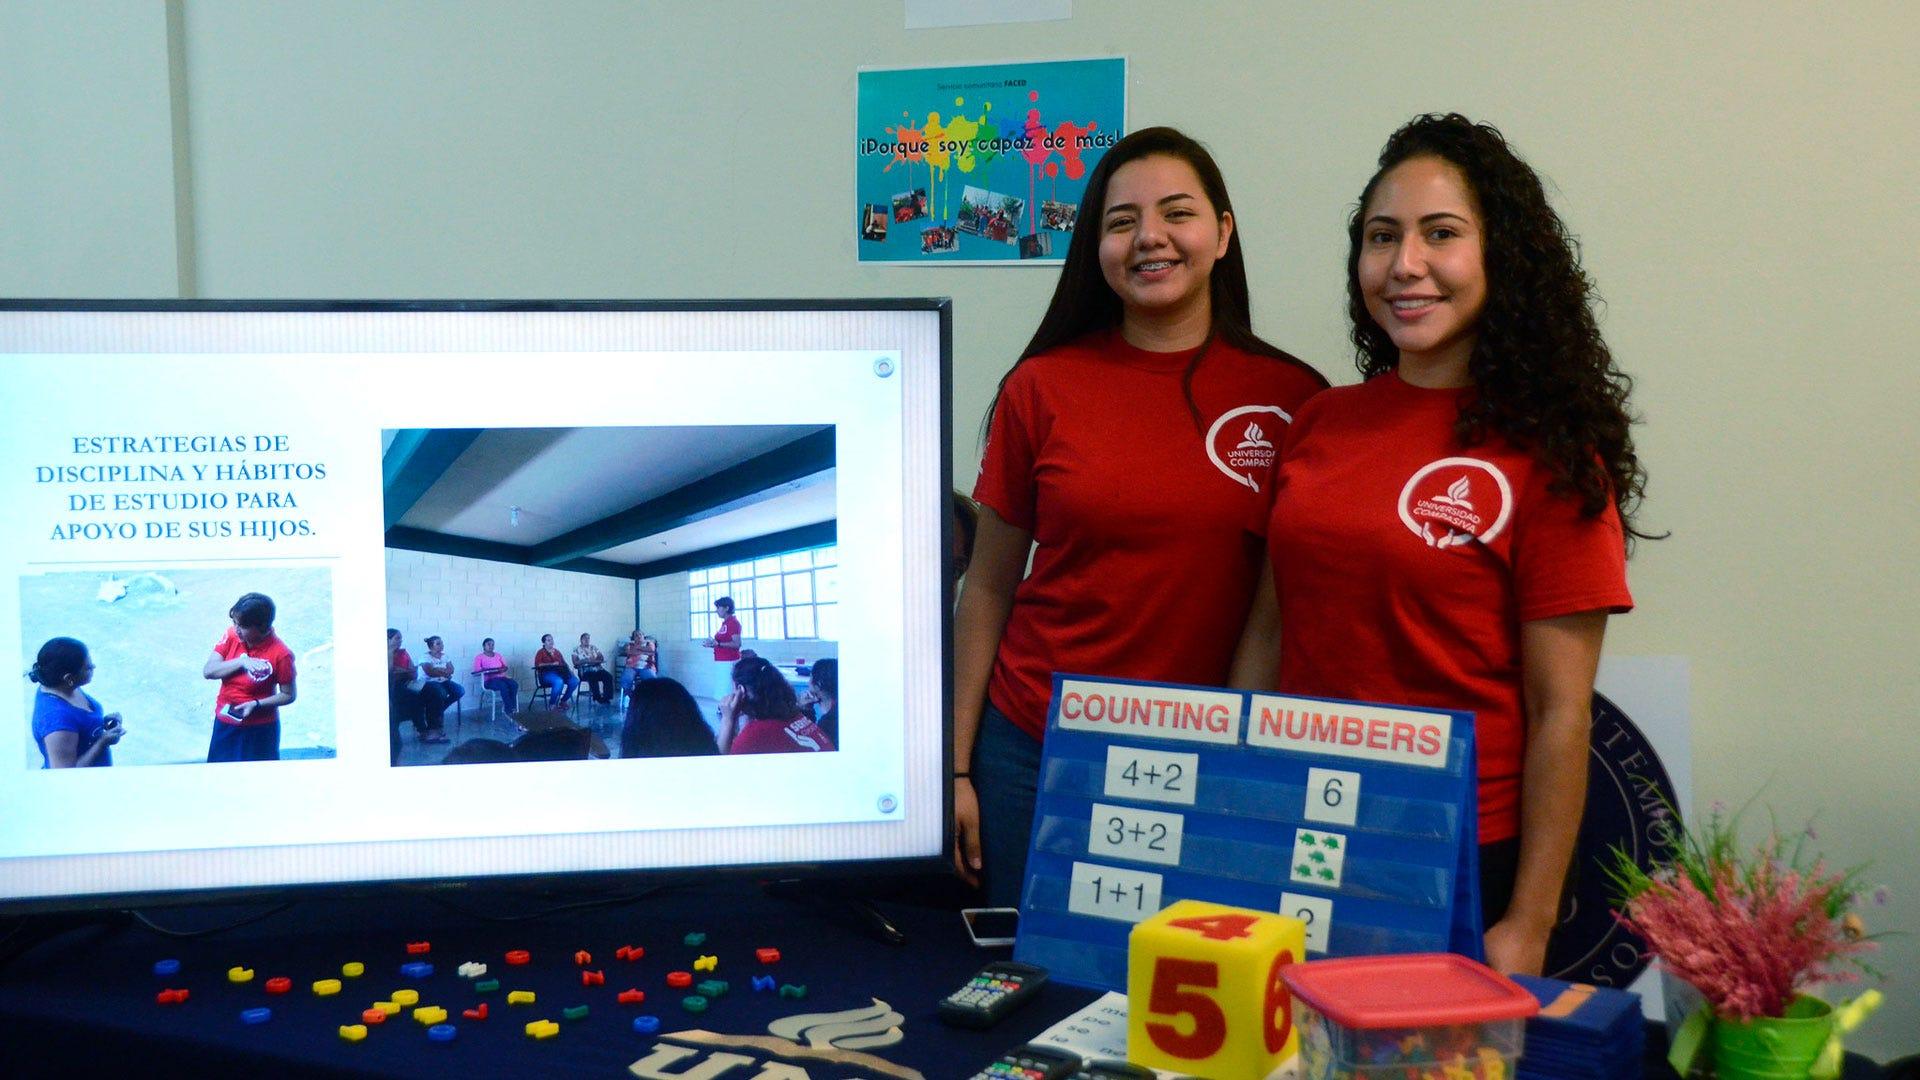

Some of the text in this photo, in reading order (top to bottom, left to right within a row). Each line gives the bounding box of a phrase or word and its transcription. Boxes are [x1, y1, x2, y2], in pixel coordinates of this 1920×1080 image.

[938, 138, 971, 156] soy
[977, 135, 1036, 156] capaz
[1042, 131, 1066, 150] de
[1075, 129, 1121, 149] más!
[72, 435, 290, 454] ESTRATEGIAS DE
[35, 459, 327, 483] DISCIPLINA Y HÁBITOS
[1230, 457, 1273, 467] COMPAS
[69, 492, 298, 511] DE ESTUDIO PARA
[1417, 499, 1481, 524] UNIVERSIDAD
[50, 519, 316, 541] APOYO DE SUS HIJOS.
[1413, 507, 1476, 533] COMPASIVA
[1061, 691, 1230, 732] COUNTING
[1259, 707, 1442, 756] NUMBERS
[1121, 760, 1184, 792] 4+2
[1323, 778, 1344, 807] 6
[1106, 816, 1168, 851] 3+2
[1091, 876, 1146, 910] 1+1
[1167, 914, 1262, 941] 4
[1145, 956, 1227, 1061] 5
[1263, 949, 1294, 1055] 6
